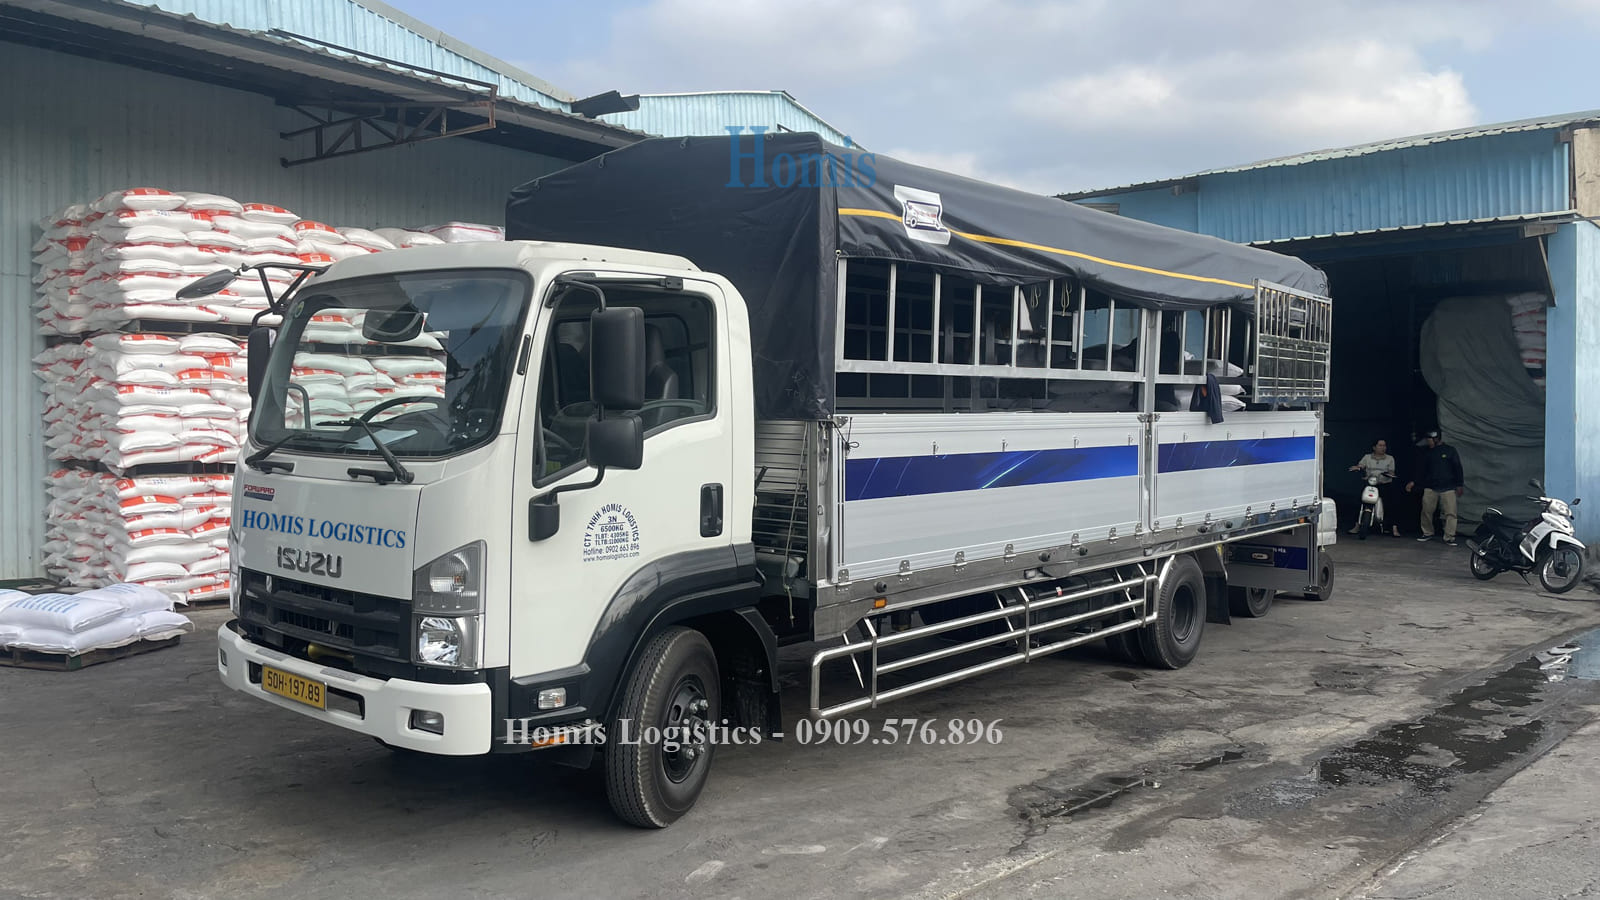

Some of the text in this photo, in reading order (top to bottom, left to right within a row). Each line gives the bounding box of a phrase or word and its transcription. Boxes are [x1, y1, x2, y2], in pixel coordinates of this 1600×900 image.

[244, 484, 275, 495] FORWARD
[242, 509, 406, 549] HOMIS LOGISTICS
[583, 503, 640, 547] CTY TNHH HOMIS LOGISTICS
[600, 524, 623, 532] 6500KG
[605, 545, 618, 553] 0902
[277, 545, 342, 578] ISUZU
